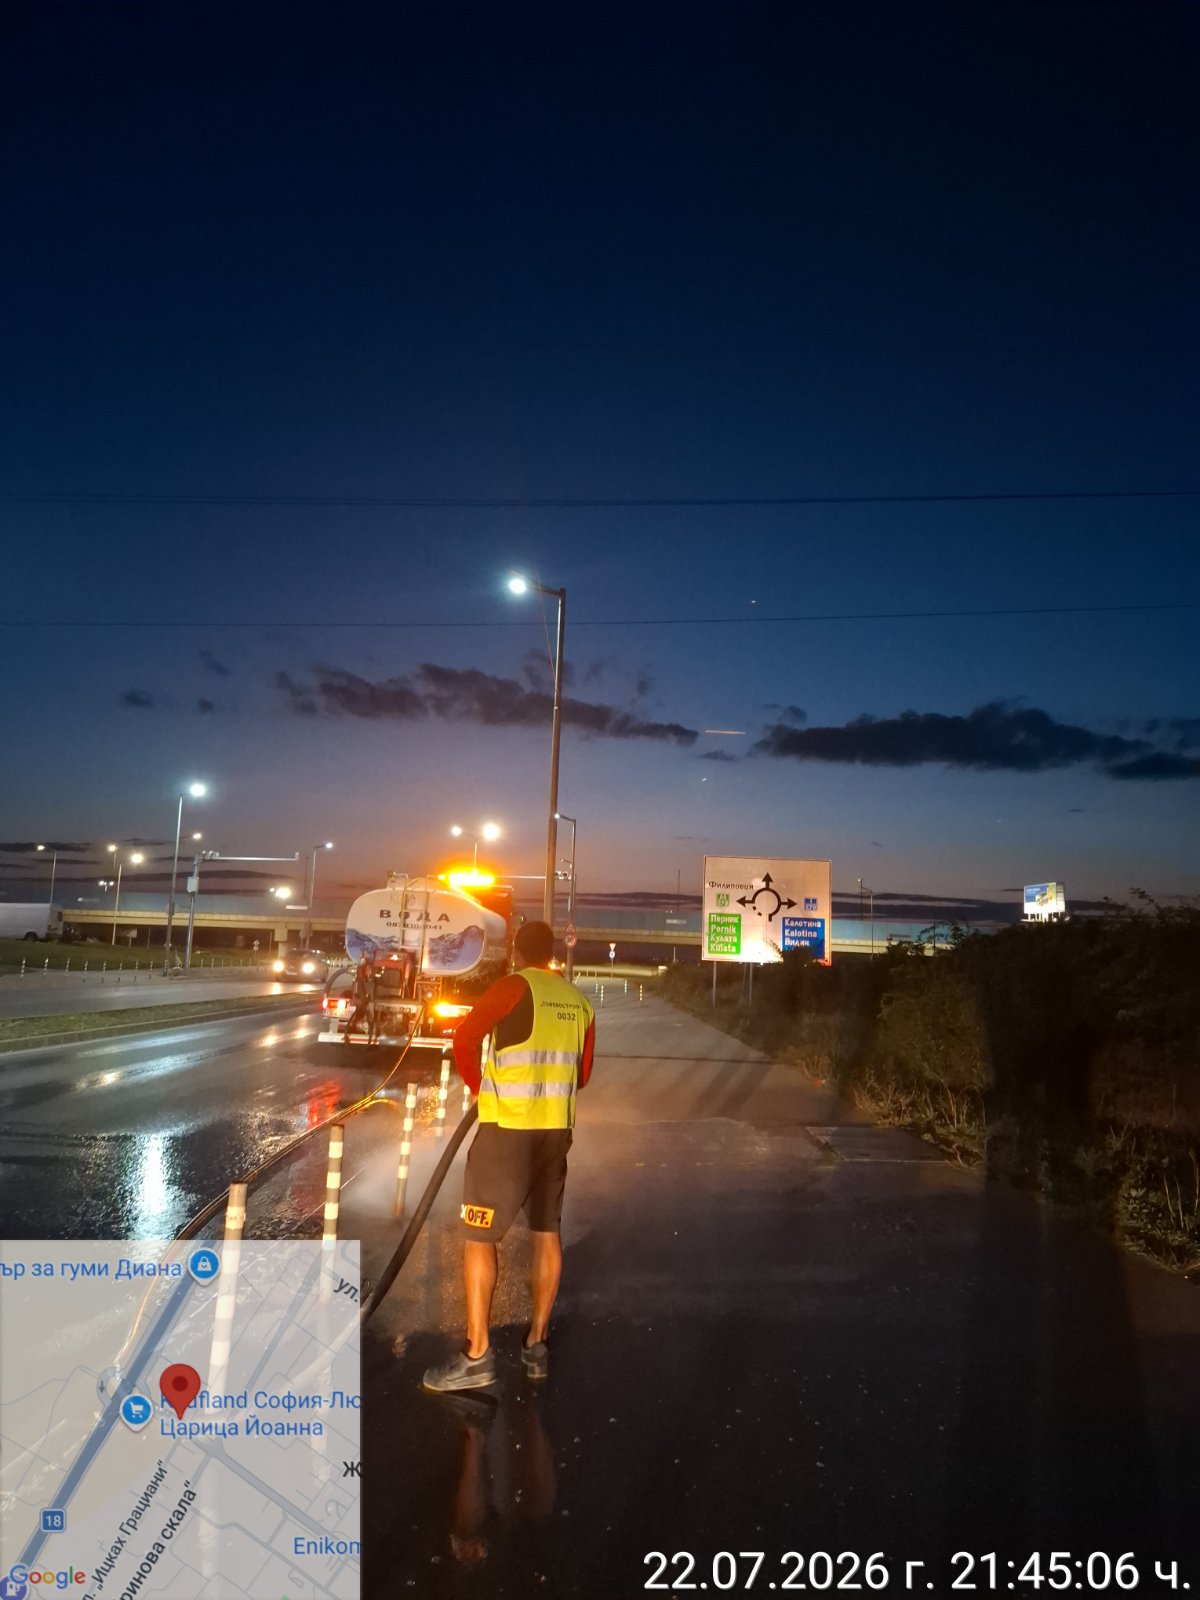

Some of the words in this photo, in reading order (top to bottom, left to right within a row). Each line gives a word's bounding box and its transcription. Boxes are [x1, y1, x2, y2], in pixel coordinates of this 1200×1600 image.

[708, 881, 754, 890] Филиповци
[379, 909, 450, 922] ВОДА
[711, 915, 739, 923] Перник
[784, 919, 822, 928] Калотина
[711, 925, 737, 933] Pernik
[784, 929, 818, 938] Kalotina
[711, 934, 738, 944] Кулата
[784, 938, 810, 947] Видин
[710, 943, 737, 952] Kulata
[557, 1012, 577, 1021] 0032
